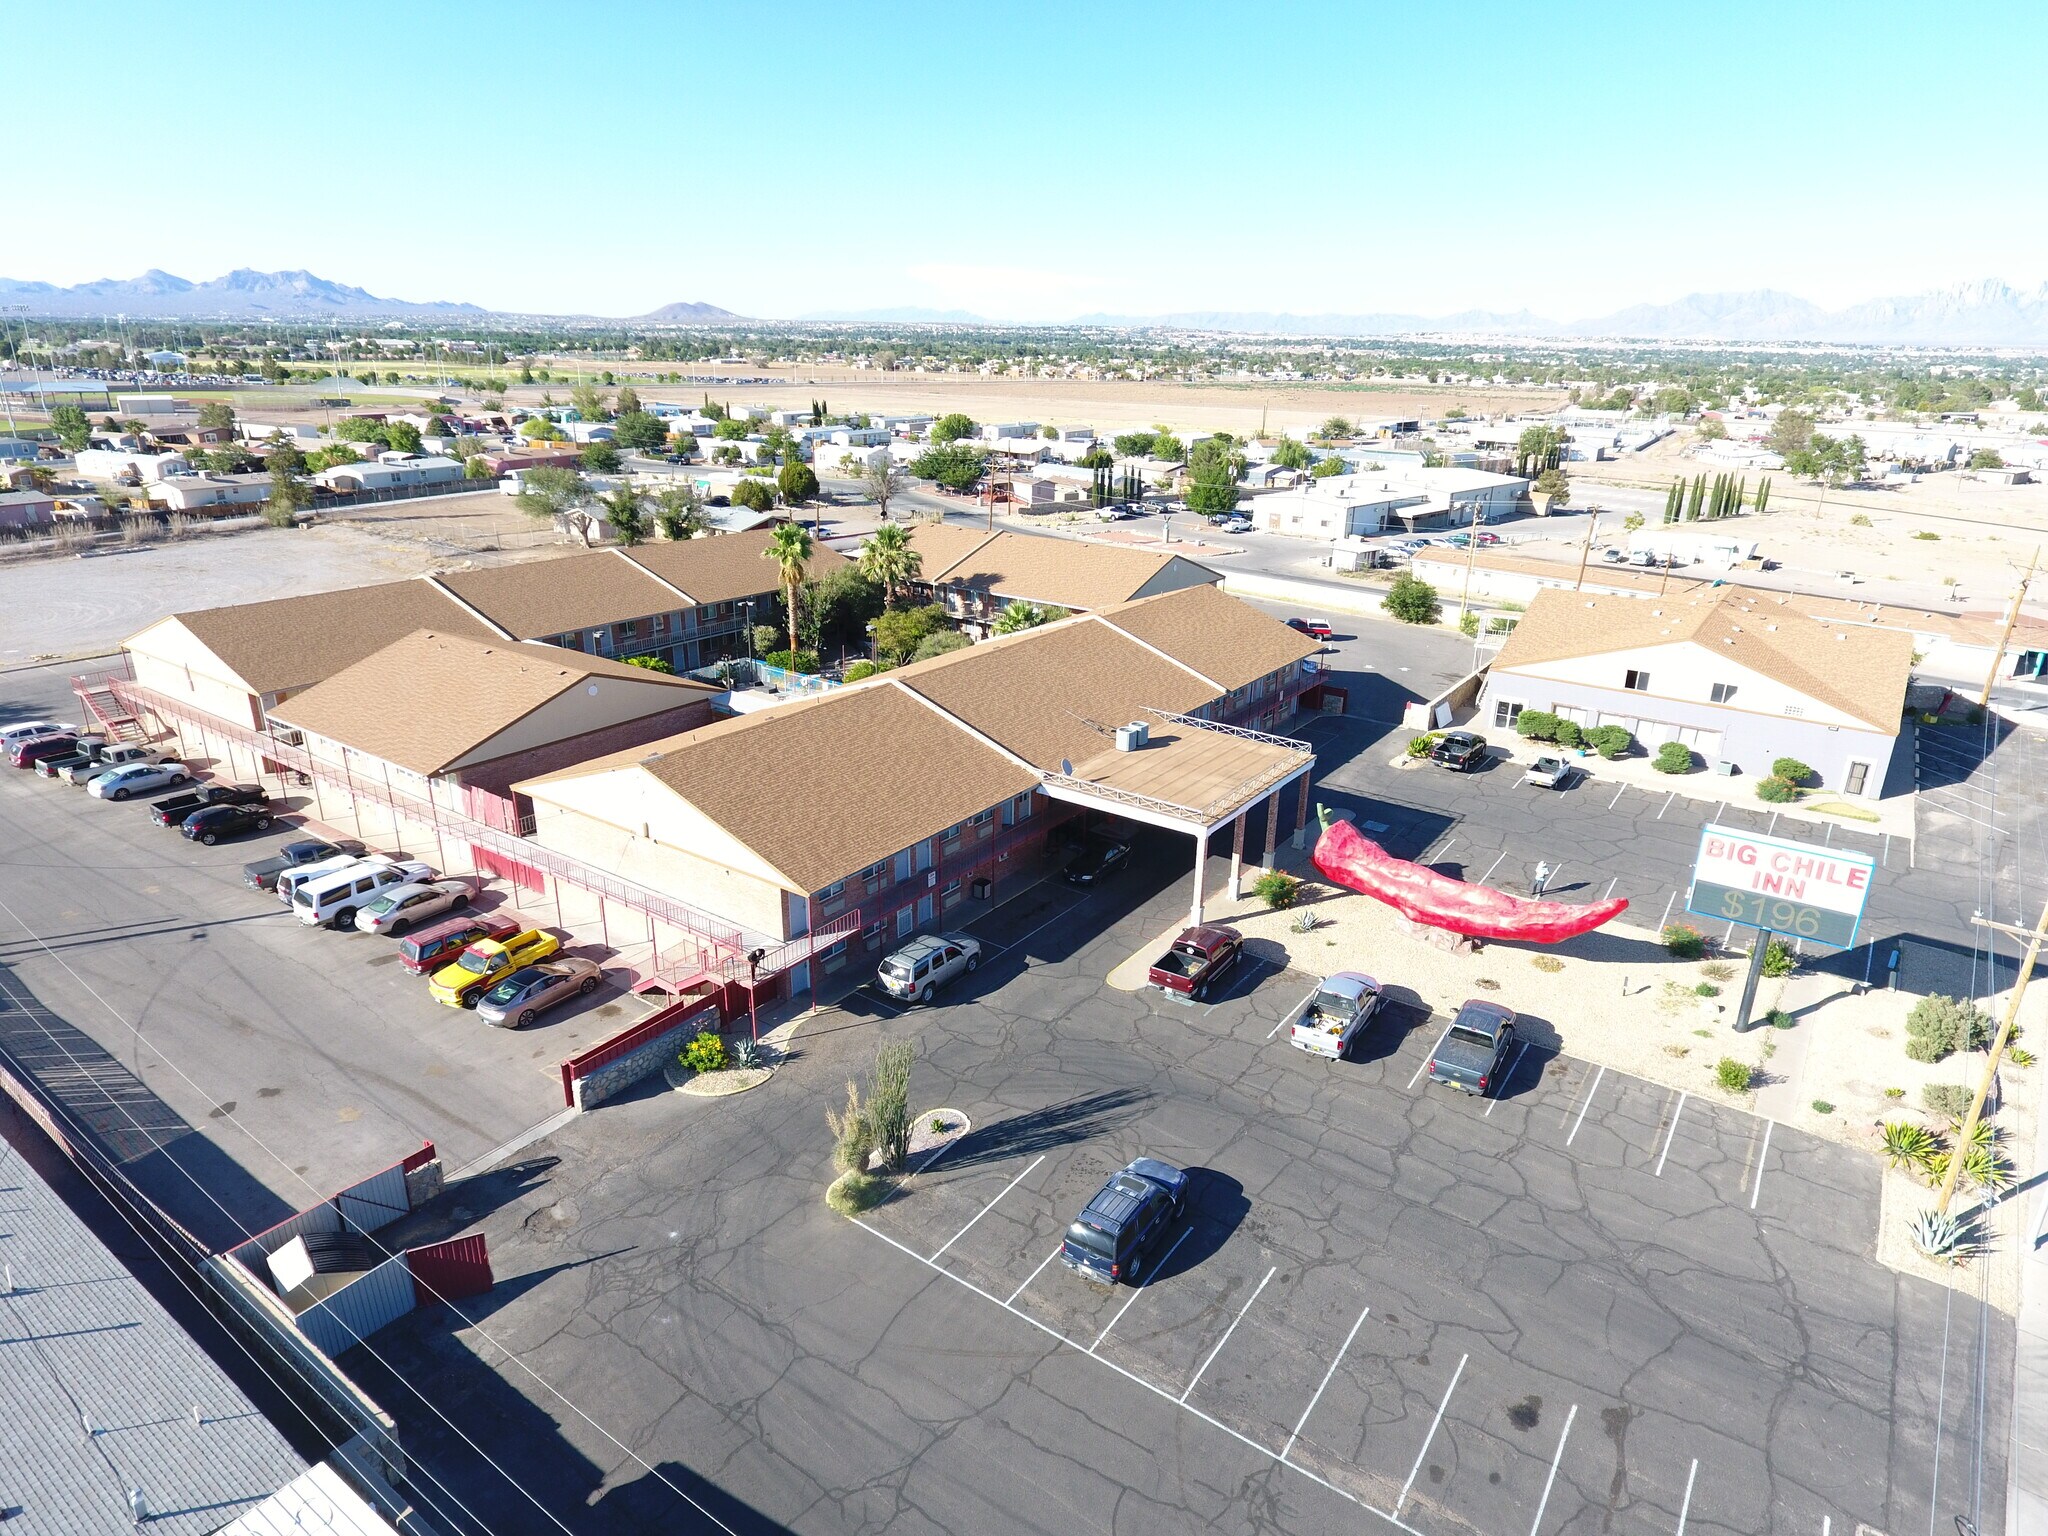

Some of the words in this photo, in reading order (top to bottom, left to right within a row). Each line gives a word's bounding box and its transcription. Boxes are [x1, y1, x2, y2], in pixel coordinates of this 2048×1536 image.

[1705, 837, 1758, 866] BIG
[1770, 852, 1868, 890] CHILE
[1751, 870, 1807, 899] INN
[1721, 890, 1821, 936] $196
